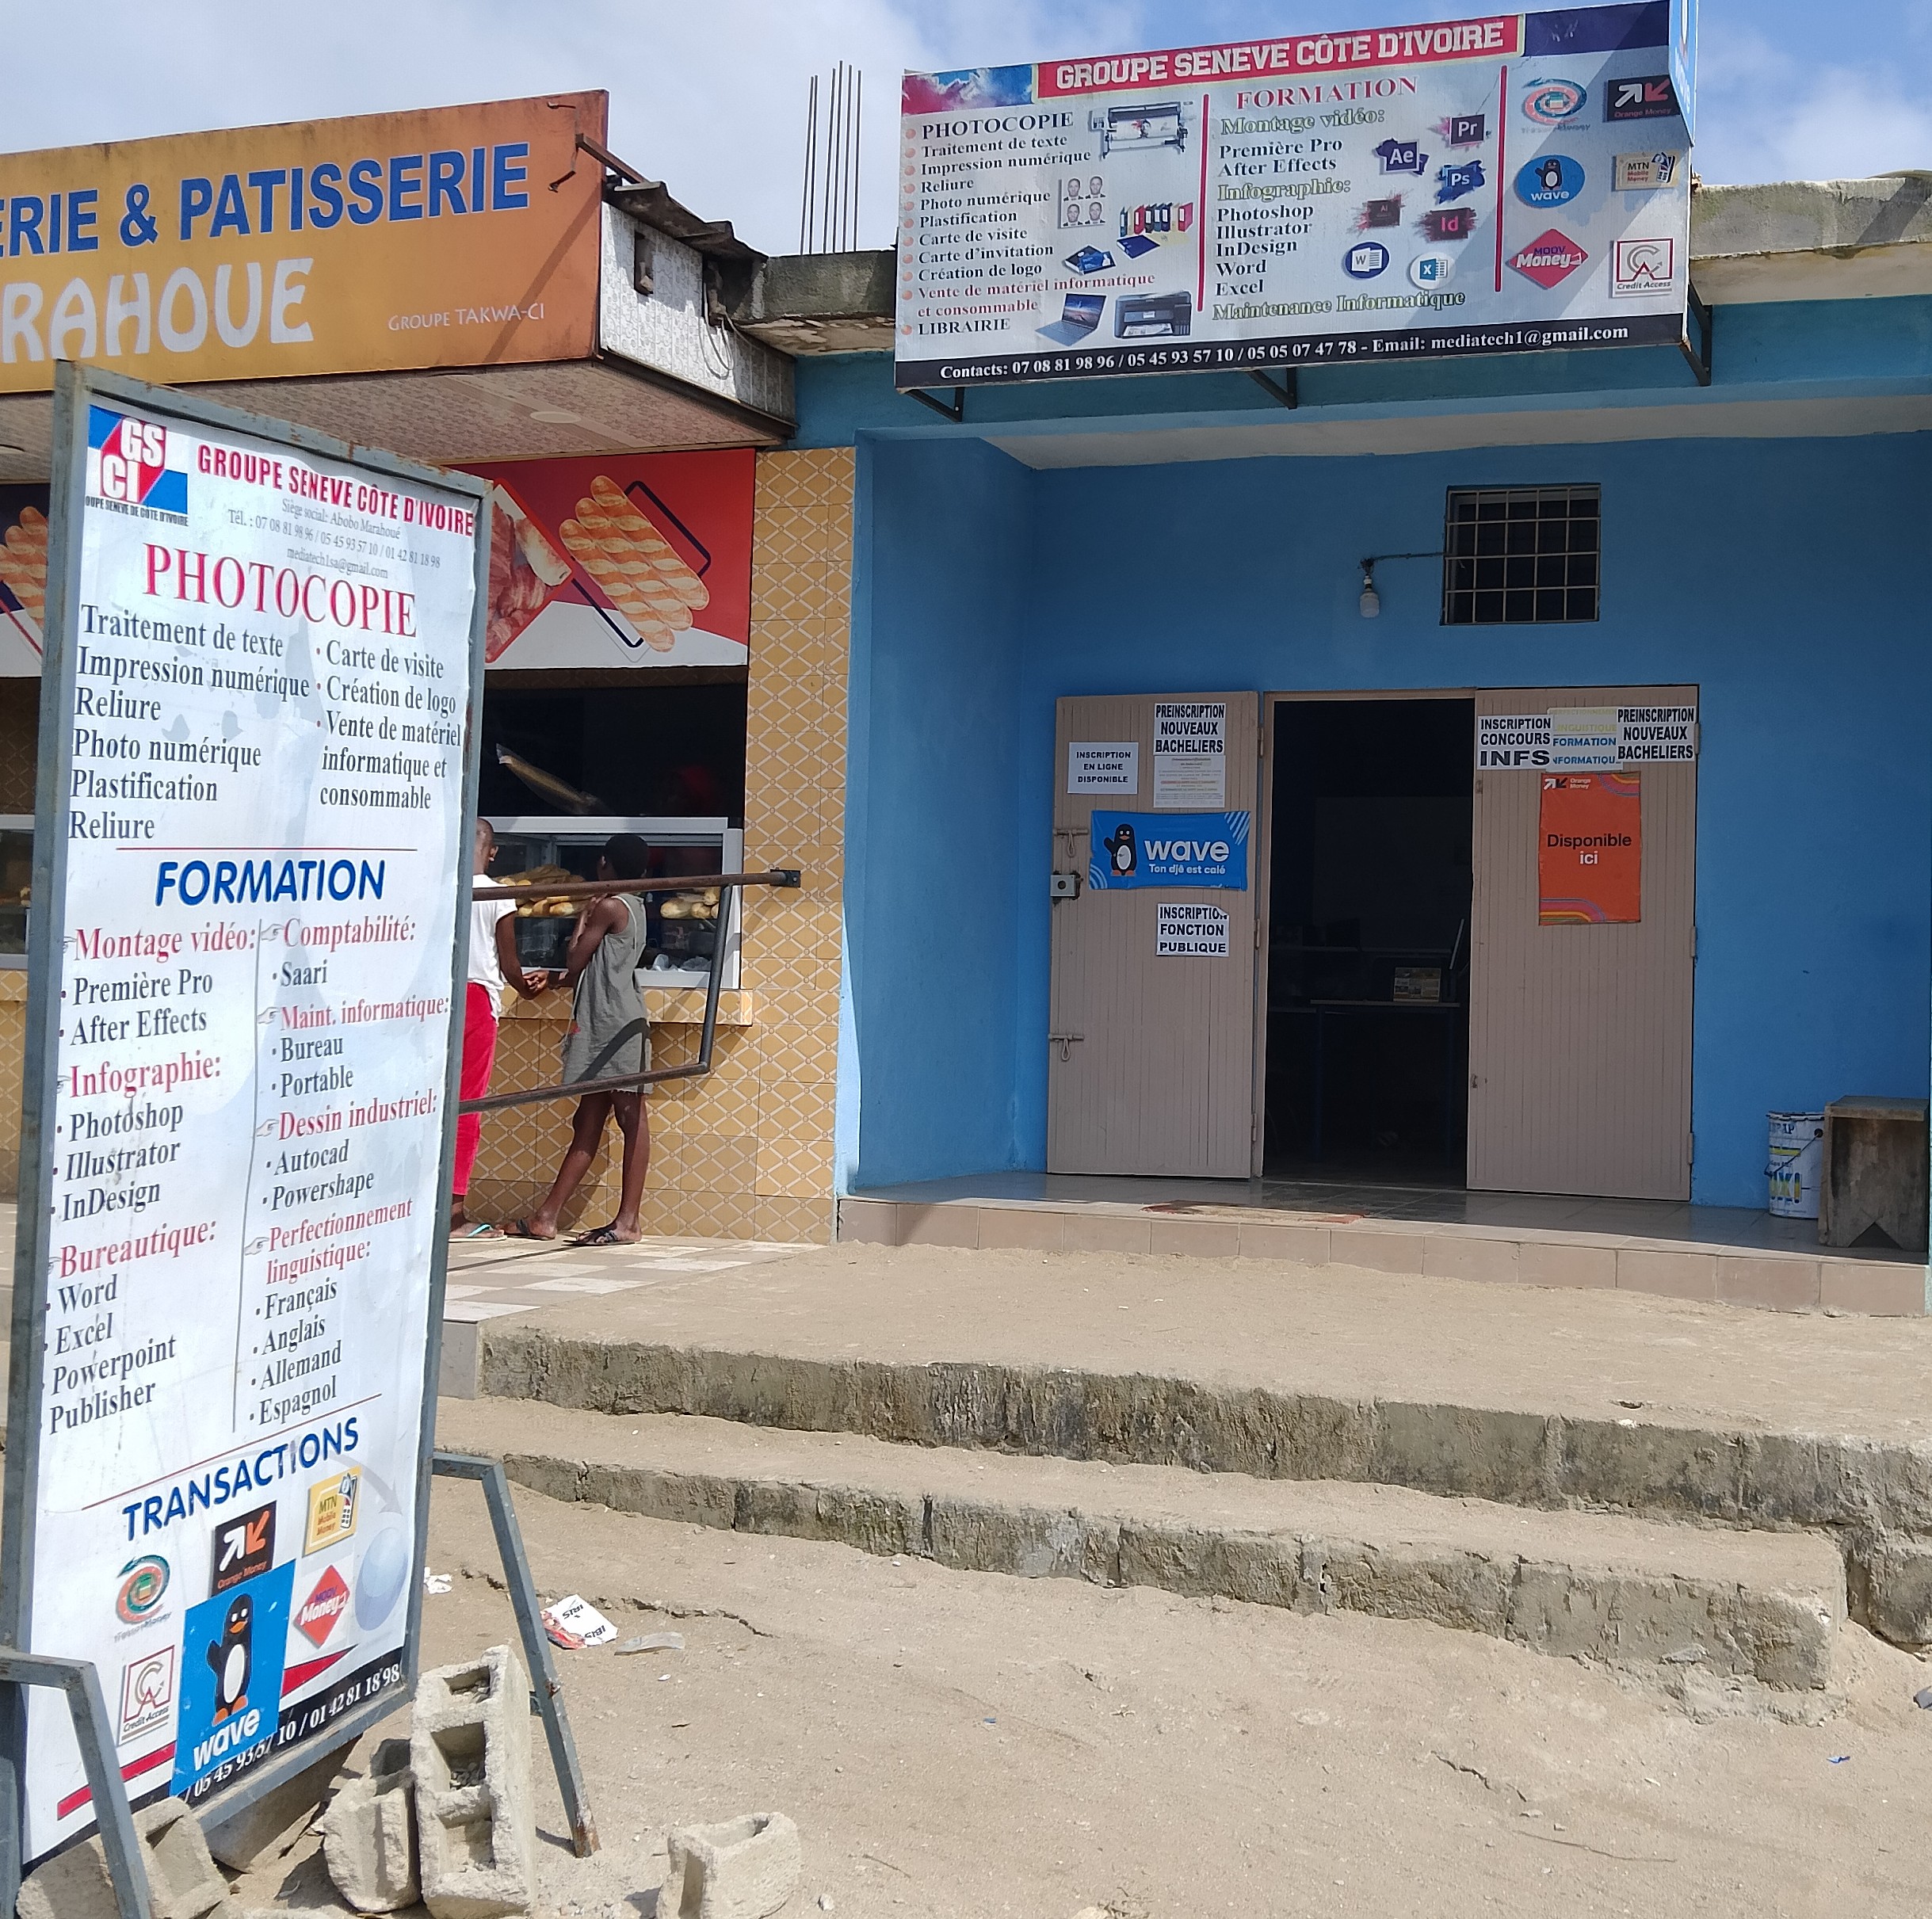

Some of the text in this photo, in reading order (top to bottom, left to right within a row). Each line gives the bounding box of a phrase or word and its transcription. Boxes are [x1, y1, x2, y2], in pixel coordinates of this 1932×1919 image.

[1056, 21, 1505, 90] GROUPE SENEVE CÔTE D'IVOIRE
[1236, 76, 1418, 110] FORMATION
[922, 112, 1075, 140] PHOTOCOPIE
[1221, 109, 1385, 135] Montage vidéo:
[922, 135, 1068, 158] Traitement de texte
[1220, 138, 1343, 158] Première Pro
[921, 149, 1092, 177] Impression numérique
[1218, 156, 1337, 177] After Effects
[119, 141, 530, 247] & PATISSERIE
[920, 190, 1051, 211] Photo numérique
[921, 178, 974, 193] Reliure
[1218, 179, 1351, 201] Infographie:
[1531, 189, 1570, 201] wave
[920, 211, 1018, 228] Plastification
[1217, 204, 1314, 222] Photoshop
[919, 227, 1028, 246] Carte de visite
[1217, 222, 1312, 239] Illustrator
[919, 250, 960, 264] Carte
[1216, 240, 1298, 257] InDesign
[918, 261, 1043, 282] Création de logo
[1216, 260, 1267, 277] Word
[918, 273, 1155, 299] Vente de matériel informatique
[1216, 279, 1264, 296] Excel
[1617, 280, 1671, 290] Credit Access
[2, 257, 315, 364] RAHOUE
[455, 302, 546, 326] TAKWA-CI
[918, 299, 1039, 318] et consommable
[1212, 290, 1465, 321] Maintenance Informatique
[918, 318, 1011, 336] LIBRAIRIE
[940, 326, 1629, 380] Contacts: 05 05 07 47 78 Email: mediatech1@gmail.com
[197, 444, 474, 537] GROUPE SENEVE CÔTE D'IVOIRE
[282, 499, 304, 517] Siège
[330, 513, 359, 530] Abobo
[361, 521, 400, 540] Marahoué
[143, 542, 417, 638] PHOTOCOPIE
[81, 604, 284, 658] Traitement de texte
[78, 646, 310, 703] Impression numérique
[326, 639, 444, 679] Carte de visite
[74, 686, 161, 720] Reliure
[326, 676, 456, 719] Création de logo
[1155, 704, 1225, 719] PREINSCRIPTION
[326, 710, 460, 746] Vente de matériel
[1160, 721, 1218, 735] NOUVEAUX
[1480, 717, 1552, 731] INSCRIPTION
[1617, 707, 1694, 723] PREINSCRIPTION
[1155, 739, 1224, 753] BACHELIERS
[1481, 732, 1551, 746] CONCOURS
[1553, 737, 1617, 747] FORMATION
[1623, 726, 1688, 741] NOUVEAUX
[73, 728, 261, 773] Photo numérique
[322, 745, 447, 782] informatique et
[1480, 750, 1550, 766] INFS
[1617, 745, 1693, 760] BACHELIERS
[71, 769, 218, 802] Plastification
[320, 786, 431, 810] consommable
[68, 811, 155, 839] Reliure
[1144, 840, 1230, 861] wave
[1547, 834, 1632, 849] Disponible
[1579, 850, 1598, 864] ici
[155, 859, 386, 906] FORMATION
[1149, 864, 1226, 875] Ton est calé
[74, 921, 255, 963] Montage vidéo:
[284, 914, 416, 952] Comptabilité:
[1160, 924, 1224, 936] FONCTION
[1159, 942, 1226, 953] PUBLIQUE
[72, 968, 212, 1005] Première Pro
[281, 959, 328, 987] Saari
[70, 1007, 207, 1046] After Effects
[281, 994, 449, 1031] Maint. informatique:
[281, 1036, 344, 1063] Bureau
[70, 1050, 221, 1099] Infographie:
[281, 1065, 353, 1098] Portable
[68, 1102, 183, 1143] Photoshop
[278, 1088, 437, 1141] Dessin industriel:
[64, 1141, 181, 1182] Illustrator
[273, 1139, 349, 1177] Autocad
[62, 1181, 160, 1222] InDesign
[270, 1172, 375, 1211] Powershape
[269, 1197, 413, 1253] Perfectionnement
[59, 1220, 216, 1279] Bureautique:
[265, 1241, 371, 1285] linguistique:
[57, 1273, 118, 1314] Word
[264, 1276, 338, 1320] Français
[54, 1312, 113, 1356] Excel
[261, 1314, 326, 1356] Anglais
[51, 1334, 176, 1396] Powerpoint
[259, 1339, 342, 1391] Allemand
[49, 1382, 156, 1436] Publisher
[258, 1375, 337, 1426] Espagnol
[122, 1417, 359, 1541] TRANSACTIONS
[193, 1707, 262, 1772] wave
